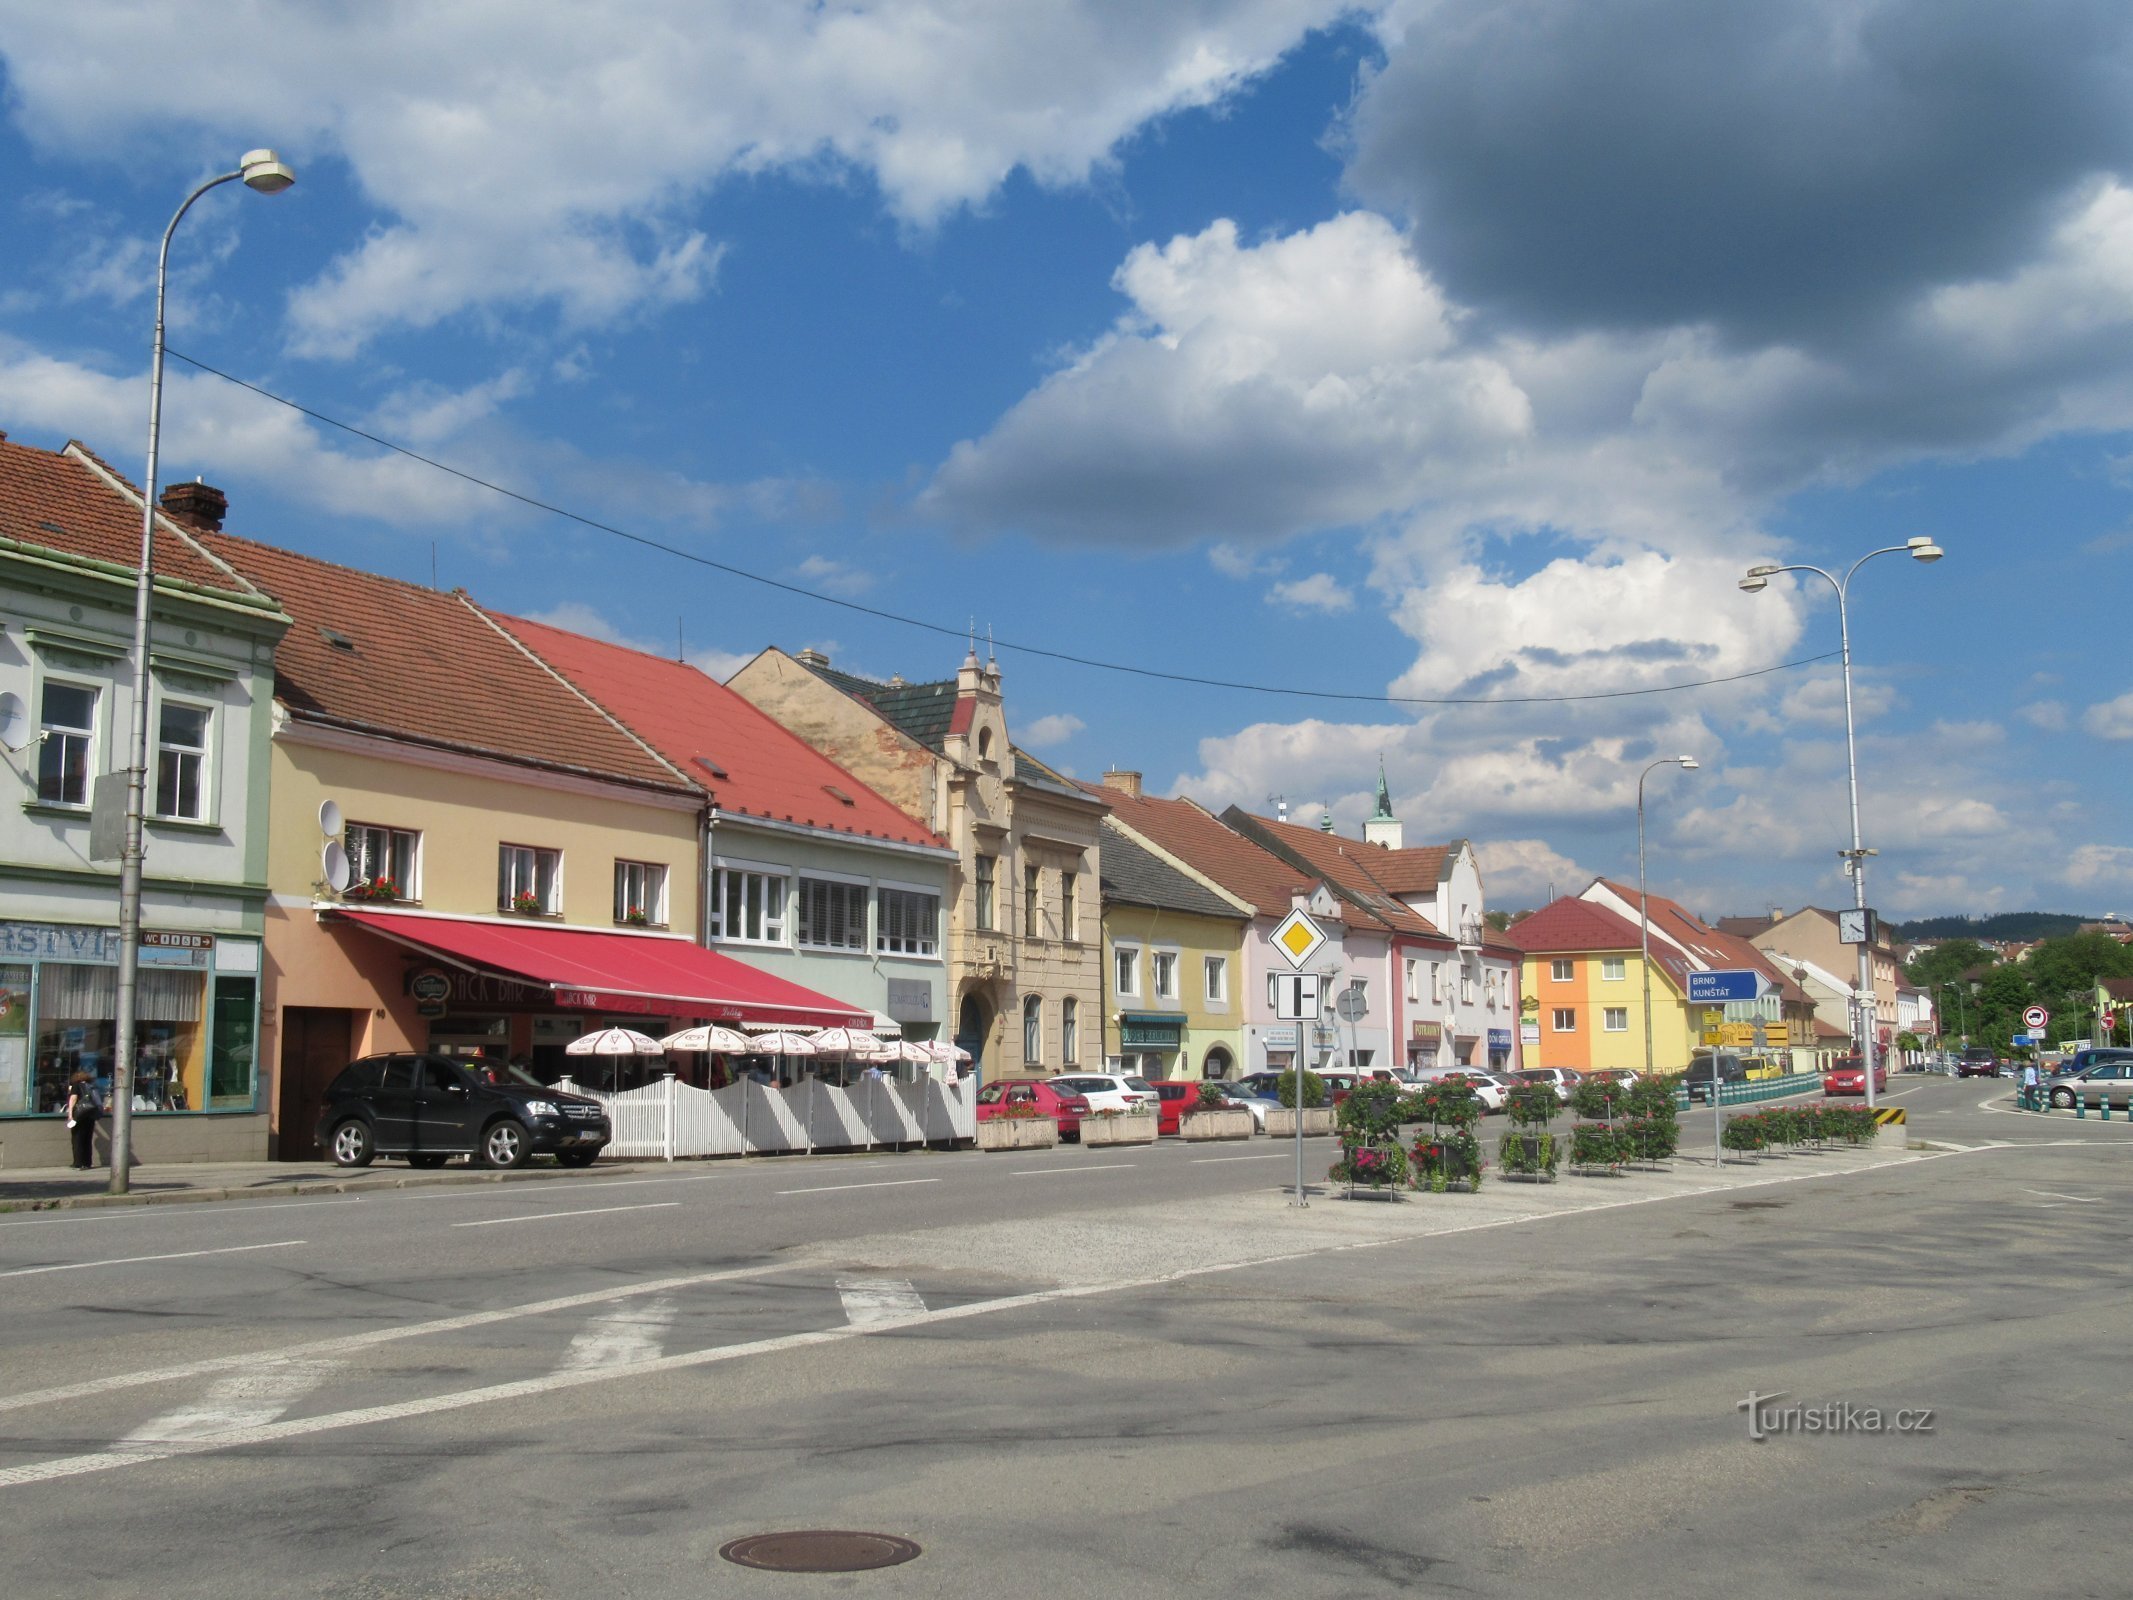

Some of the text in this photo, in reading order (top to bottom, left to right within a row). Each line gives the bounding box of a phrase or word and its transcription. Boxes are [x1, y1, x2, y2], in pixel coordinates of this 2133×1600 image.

[144, 933, 159, 944] WC
[1693, 976, 1716, 985] BRNO
[1693, 987, 1730, 997] KUNŠTÁT
